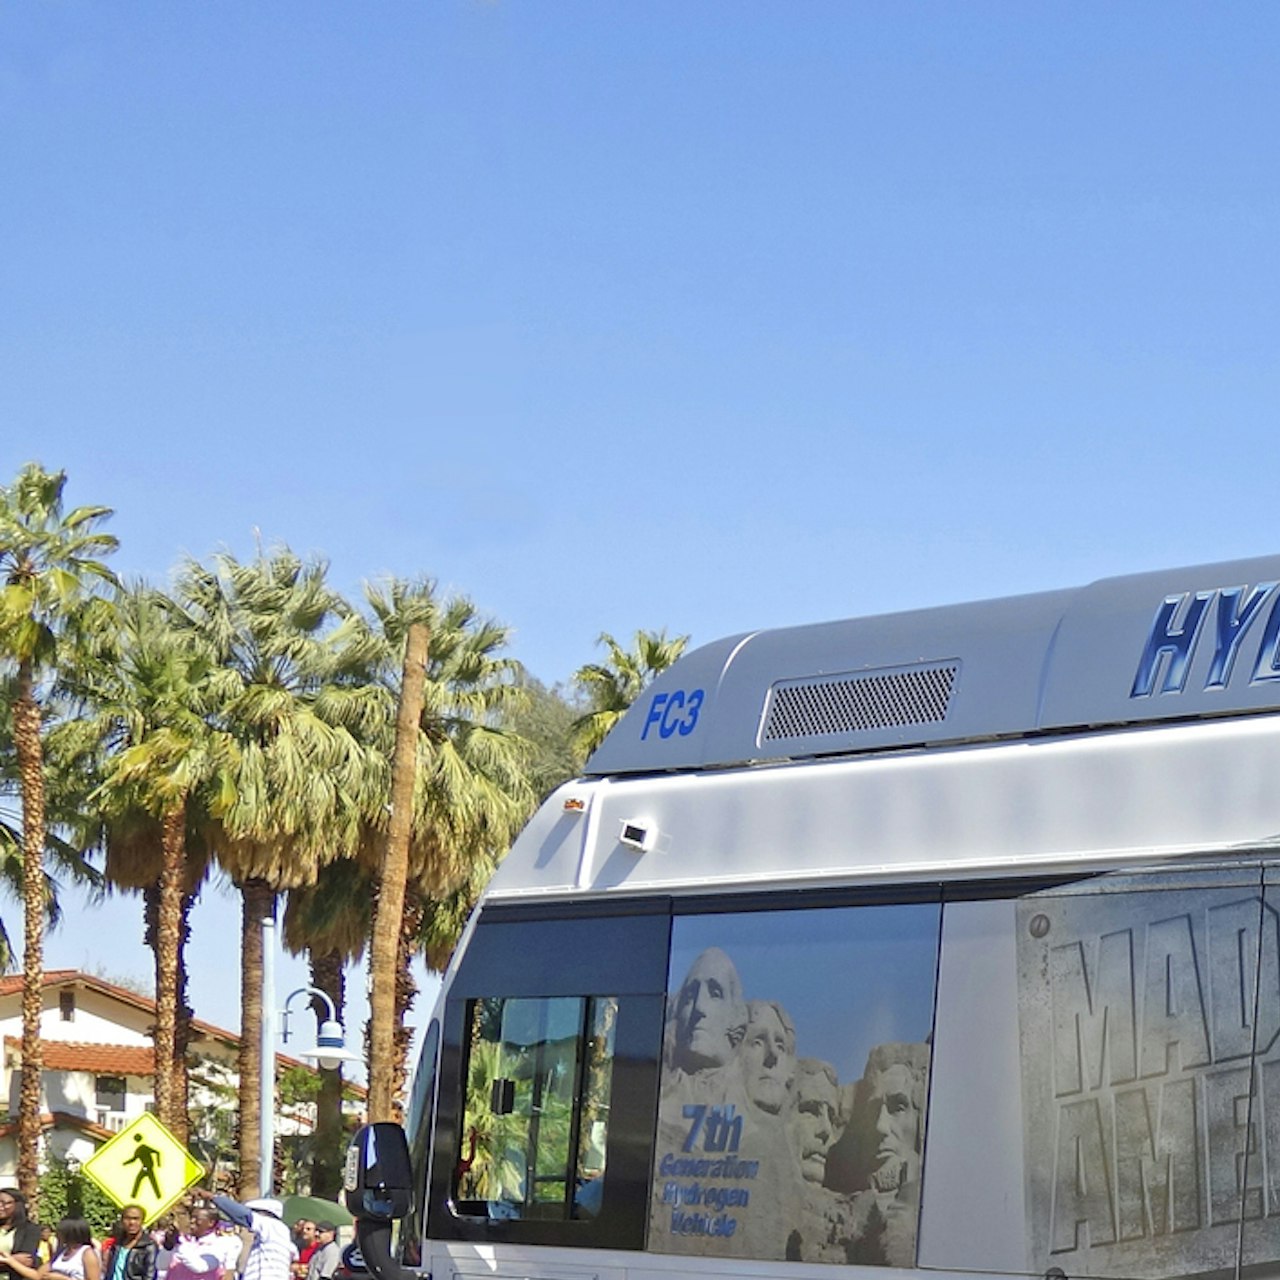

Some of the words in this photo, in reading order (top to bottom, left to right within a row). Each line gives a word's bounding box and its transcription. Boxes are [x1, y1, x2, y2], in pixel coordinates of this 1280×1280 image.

[641, 689, 704, 740] FC3
[681, 1104, 744, 1153] 7th
[659, 1153, 760, 1179] Generation
[662, 1182, 750, 1212] Hydrogen
[670, 1211, 738, 1237] Vehicle
